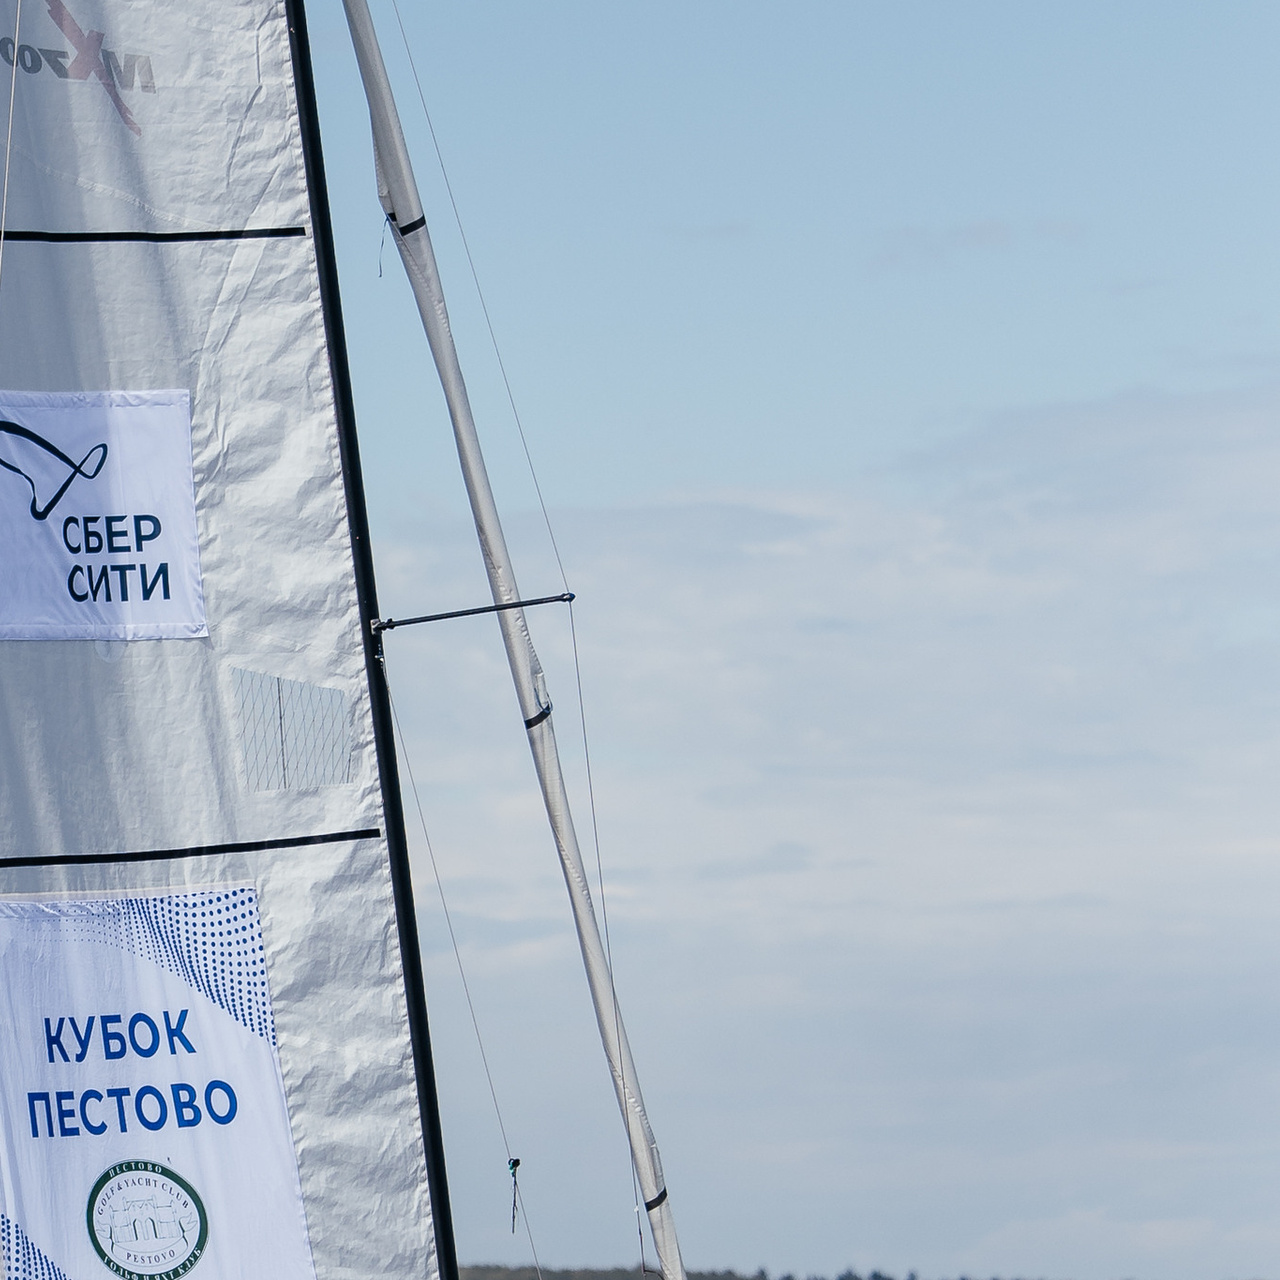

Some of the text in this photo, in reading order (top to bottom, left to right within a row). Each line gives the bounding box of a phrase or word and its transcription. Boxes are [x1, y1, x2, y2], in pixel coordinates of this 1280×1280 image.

[62, 513, 163, 555] СБЕР
[67, 562, 171, 603] СИТИ
[43, 1008, 197, 1065] КУБОК
[26, 1079, 239, 1139] ПЕСТОВО
[108, 1161, 163, 1179] ПЕСТОВО
[161, 1181, 190, 1209] CLUB
[126, 1248, 176, 1265] PESTOVO
[178, 1247, 202, 1275] КЛУБ
